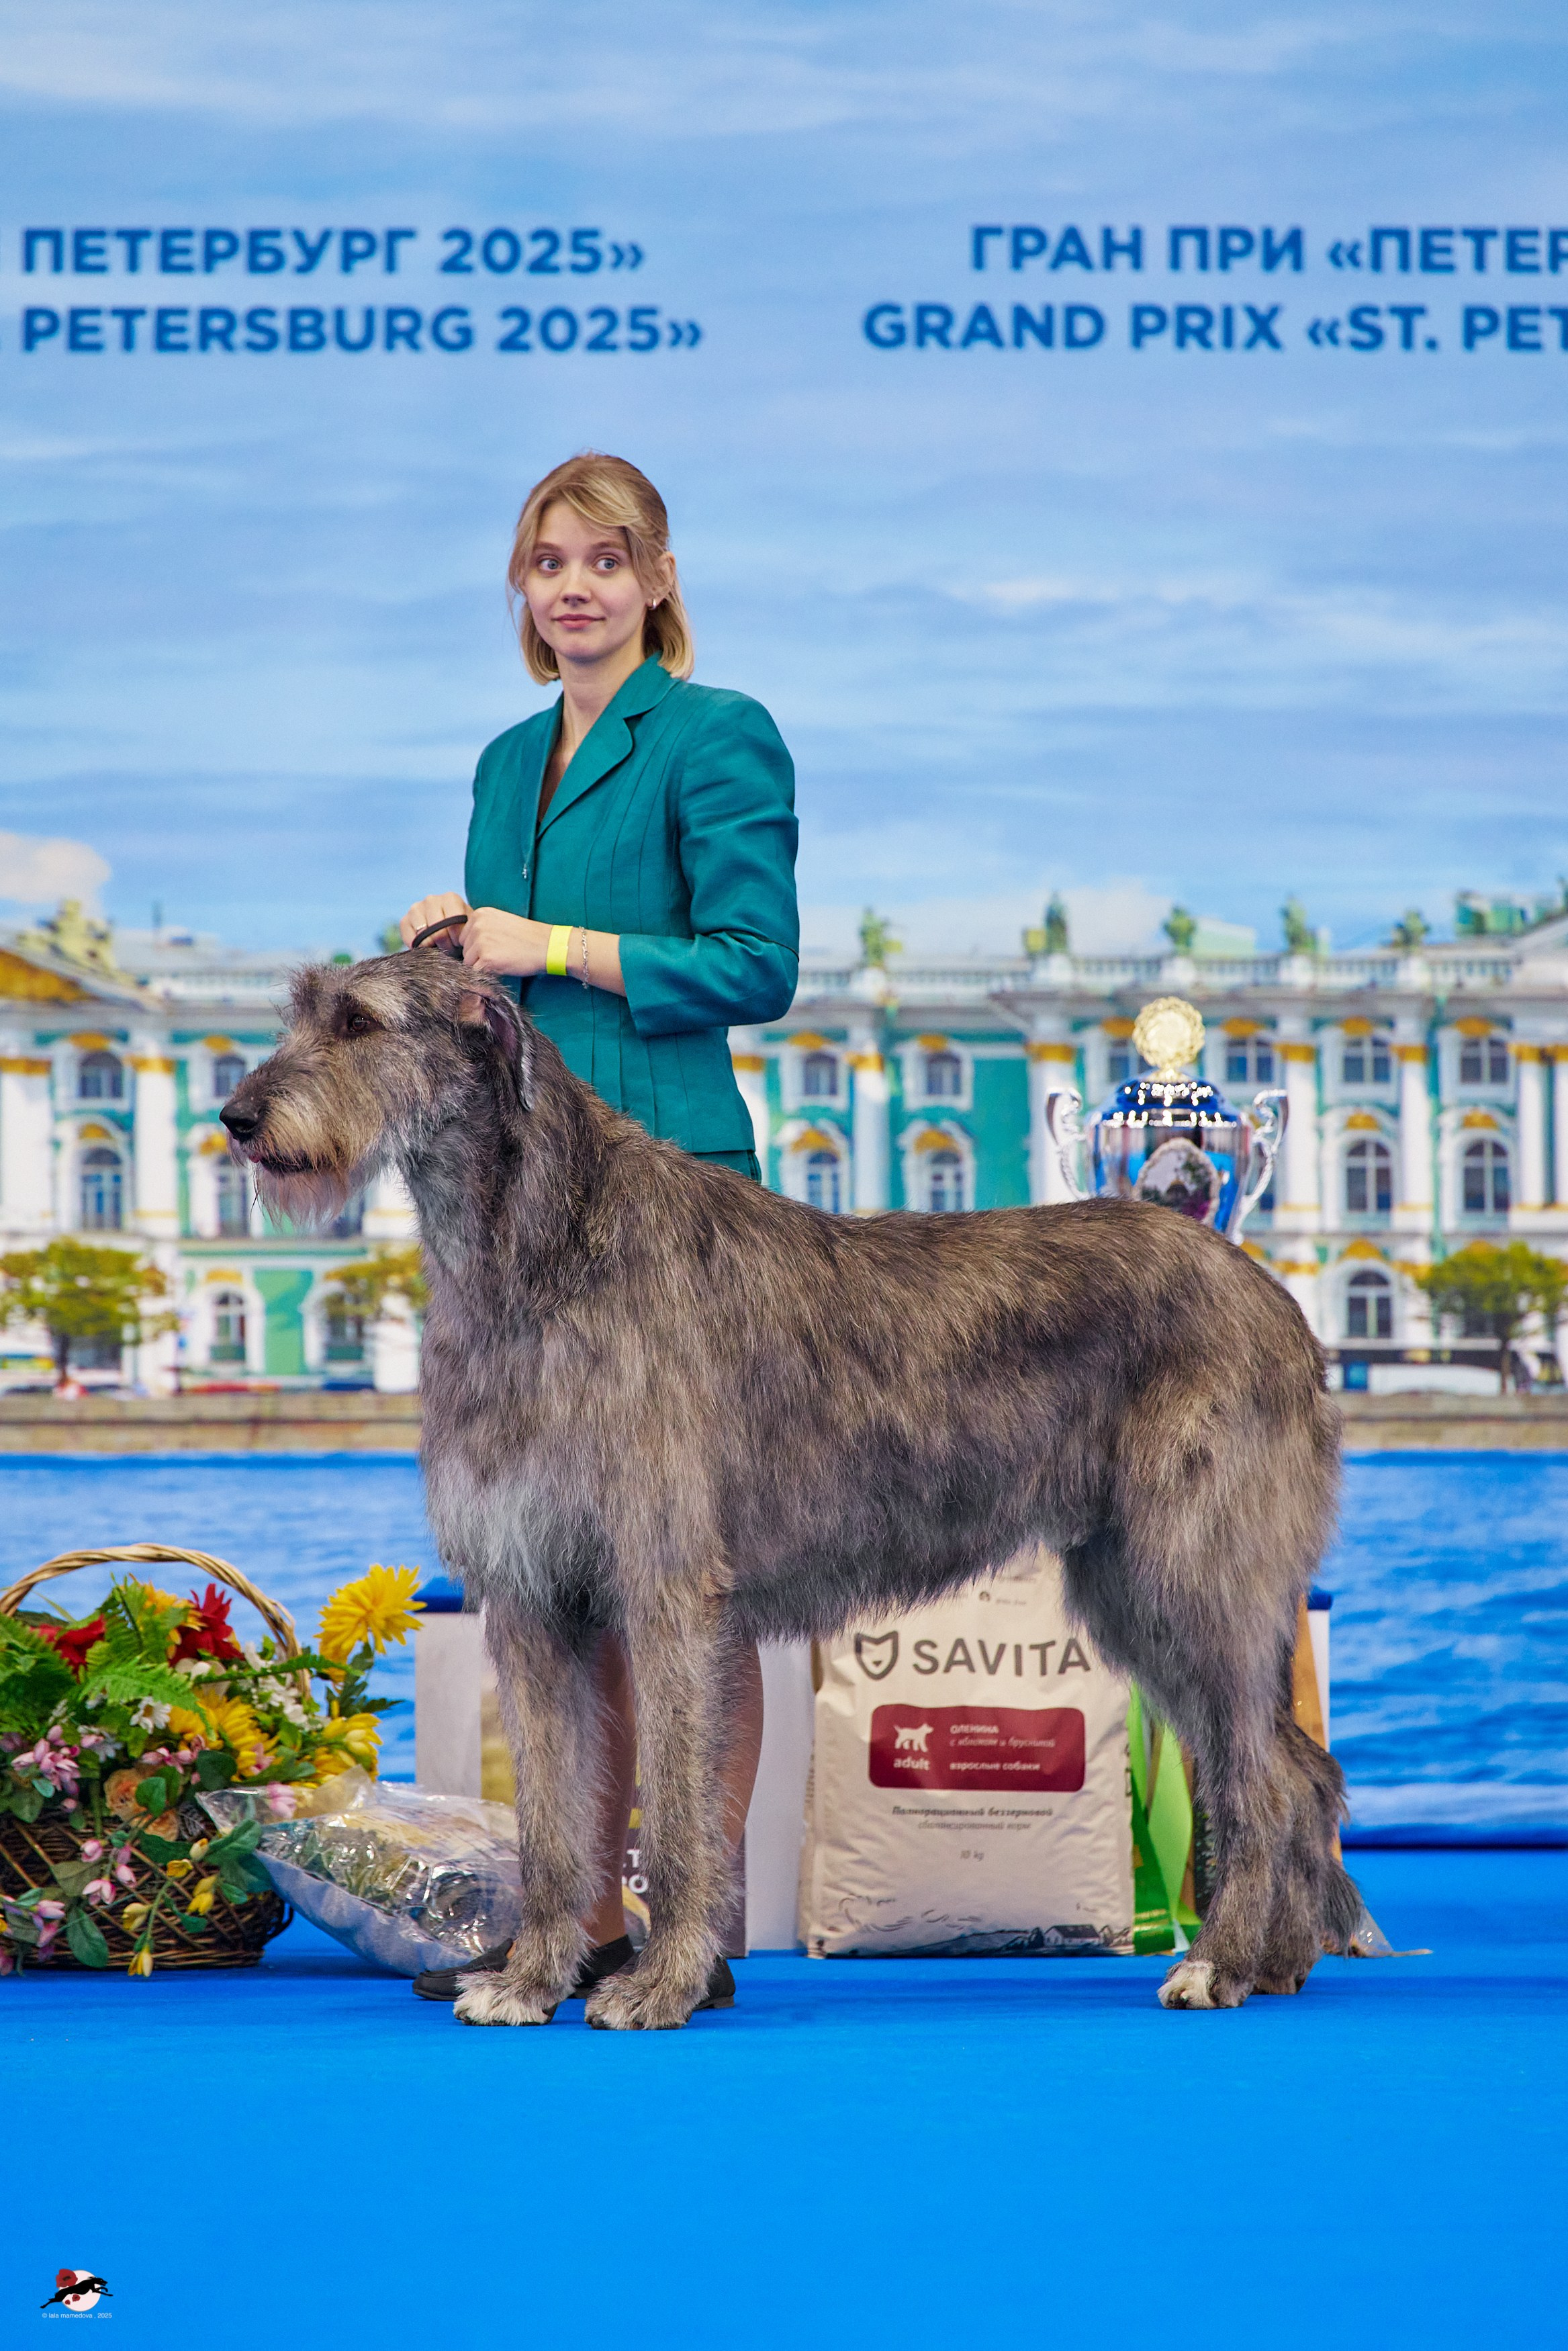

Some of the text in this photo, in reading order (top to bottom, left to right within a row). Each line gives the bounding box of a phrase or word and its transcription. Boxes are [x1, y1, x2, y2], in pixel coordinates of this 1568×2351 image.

[23, 227, 644, 276] ПЕТЕРБУРГ 2025»
[971, 225, 1143, 273] ГРАН
[1168, 226, 1305, 273] ПРИ
[21, 306, 702, 354] PETERSBURG 2025»
[862, 302, 1106, 351] GRAND
[1129, 304, 1283, 351] PRIX
[1307, 304, 1439, 353] «ST.
[912, 1637, 1092, 1677] SAVITA
[893, 1757, 930, 1771] adult
